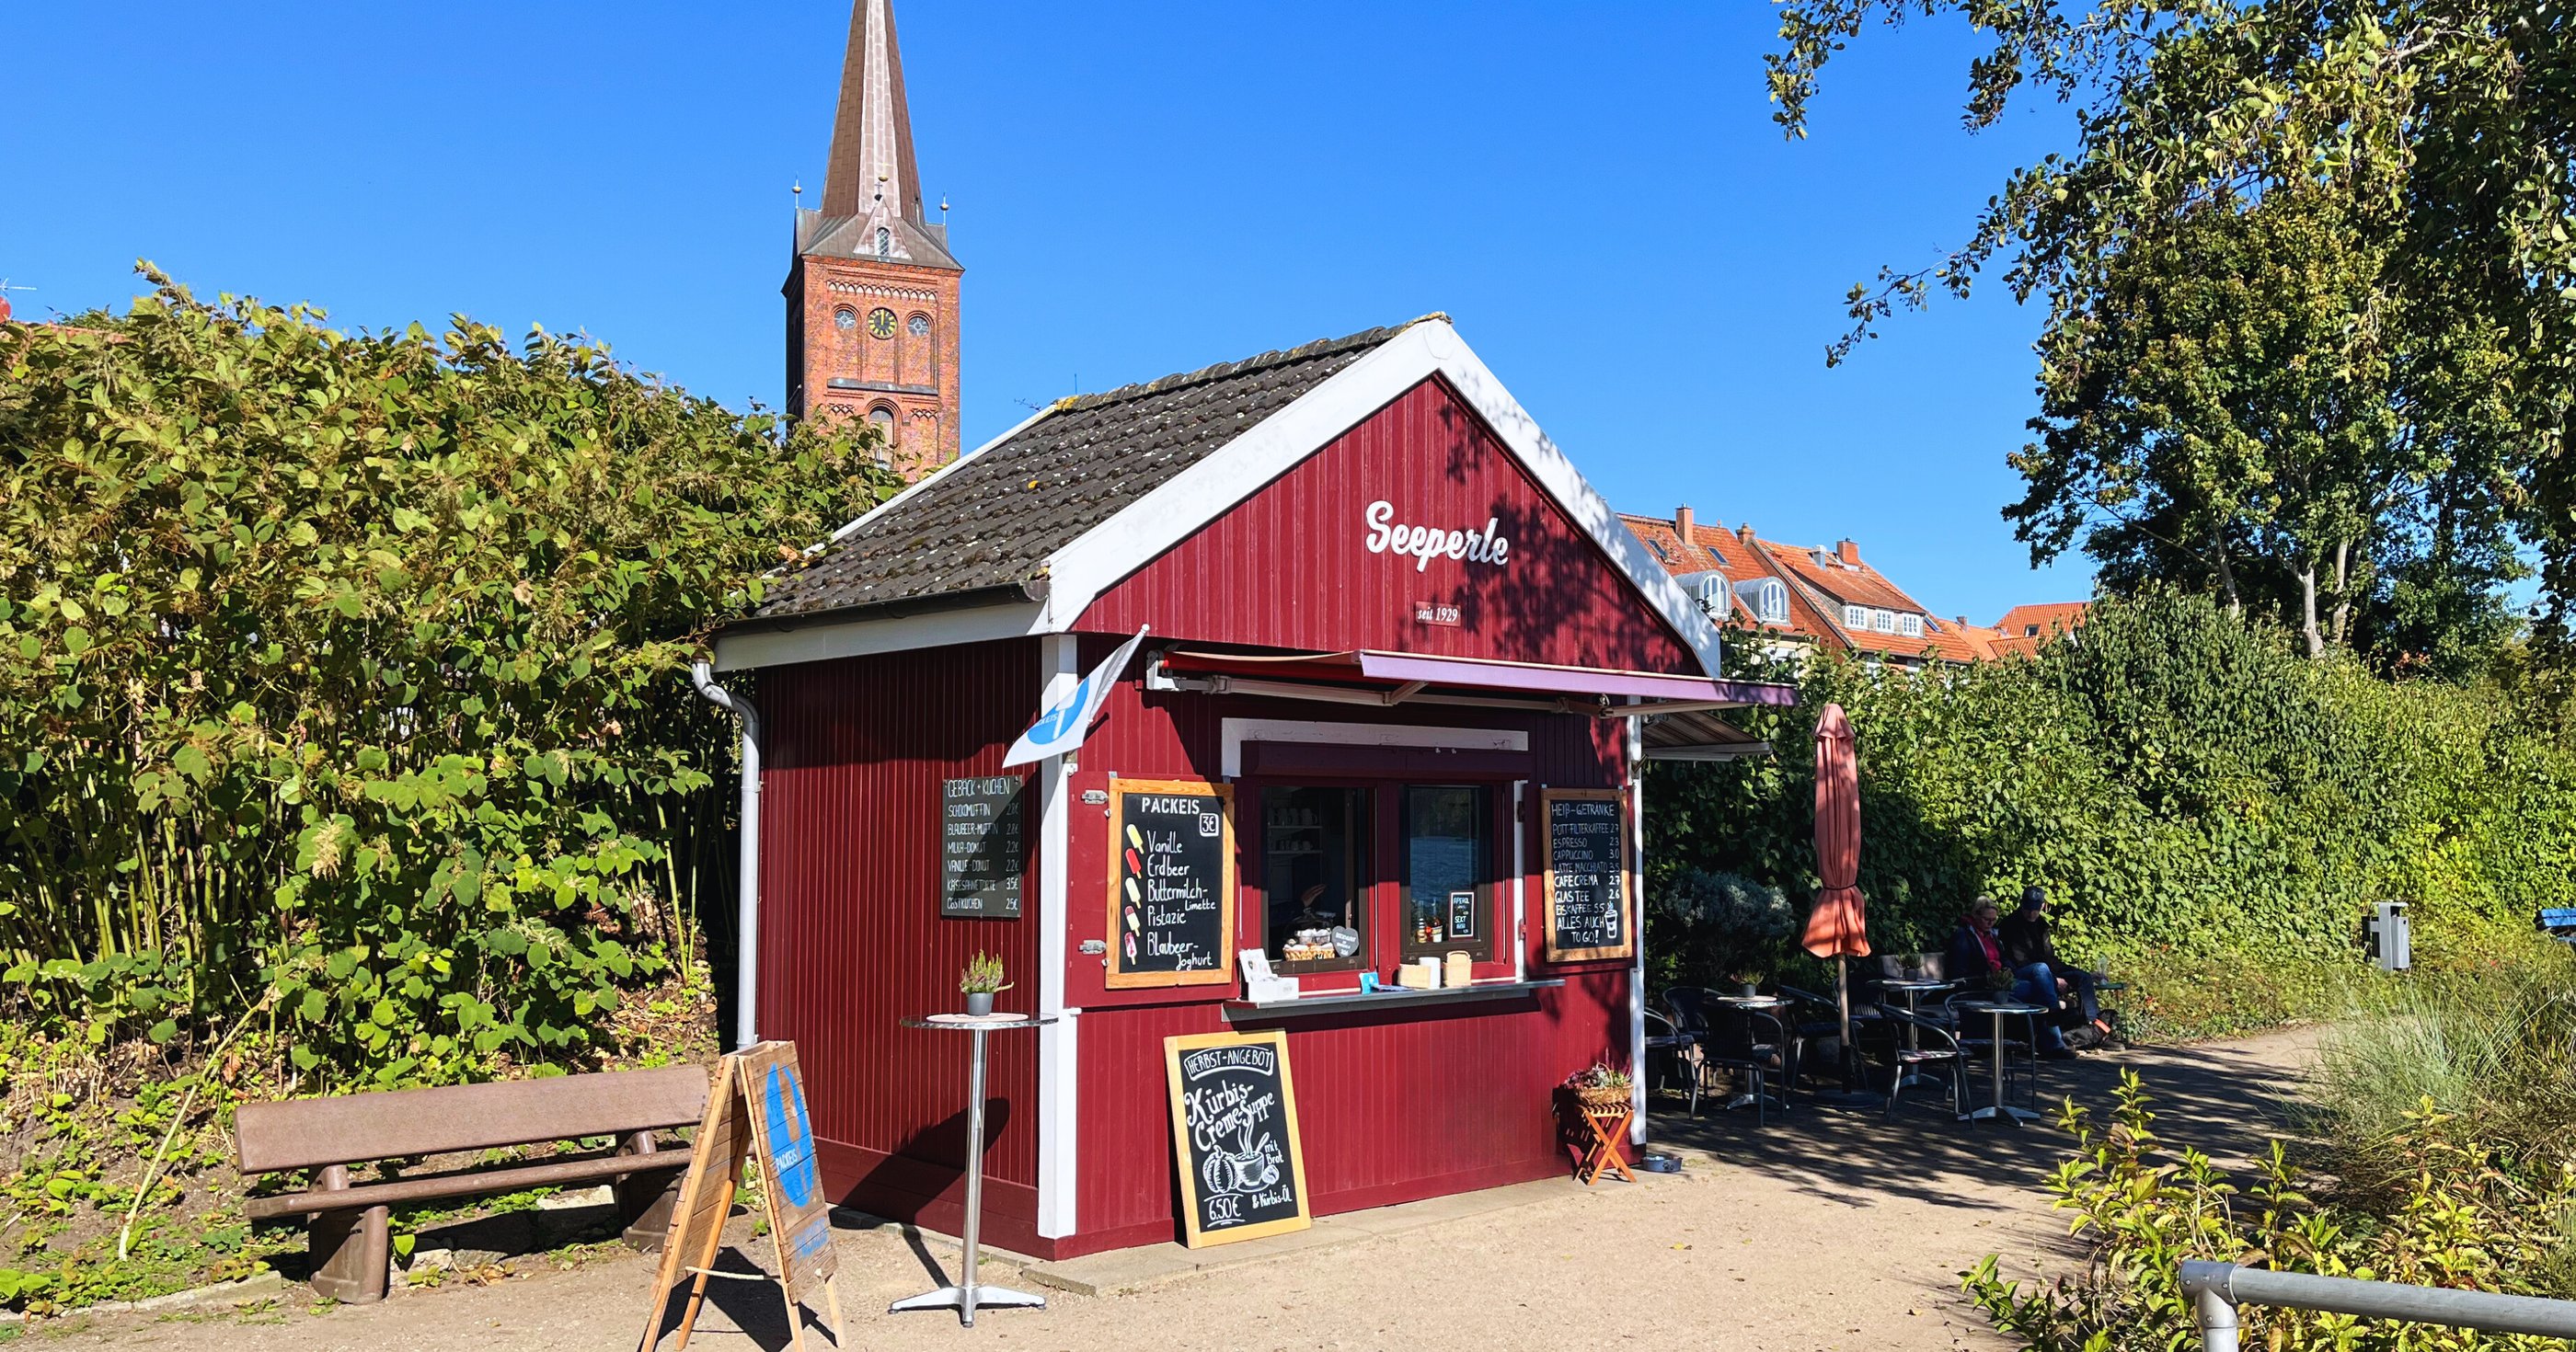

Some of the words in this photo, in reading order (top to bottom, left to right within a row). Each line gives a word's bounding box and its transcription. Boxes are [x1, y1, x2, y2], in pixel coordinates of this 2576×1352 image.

[1366, 500, 1509, 572] Seeperle
[1418, 606, 1432, 621] seit
[1436, 607, 1458, 623] 1929
[948, 779, 975, 797] GEBÄCK
[982, 778, 1010, 795] KUCHEN
[948, 803, 991, 817] SCHOKOMUFFIN
[1141, 796, 1200, 815] PACKEIS
[1202, 816, 1215, 832] 3€
[948, 842, 986, 854] MILKA-DONUT
[1146, 830, 1183, 854] Vanille
[1553, 837, 1588, 849] ESPRESSO
[1553, 850, 1593, 861] CAPPUCCINO
[948, 859, 990, 872] VANILLE-DONUT
[1147, 854, 1190, 877] Erdbeer
[1554, 863, 1573, 874] LATTE
[1574, 862, 1608, 874] MACCHIATO
[1147, 877, 1209, 901] Buttermilch-
[1554, 875, 1574, 888] CAFE
[1555, 890, 1574, 903] GLAS
[1575, 890, 1590, 901] TEE
[1185, 898, 1216, 911] Limette
[1556, 903, 1593, 916] EISKAFFEE
[1147, 904, 1187, 927] Pistazie
[1557, 916, 1582, 931] ALLES
[1584, 916, 1604, 929] AUCH
[1147, 931, 1199, 956] Blaubeer-
[1571, 931, 1581, 943] TO
[1582, 929, 1599, 944] GO!
[1176, 951, 1213, 971] Joghurt
[1188, 1049, 1273, 1074] HERBST-ANGEBOT
[1184, 1079, 1254, 1127] Kürbis-
[1195, 1093, 1275, 1151] Creme-Suppe
[1264, 1140, 1279, 1153] mit
[1266, 1150, 1284, 1164] Brot
